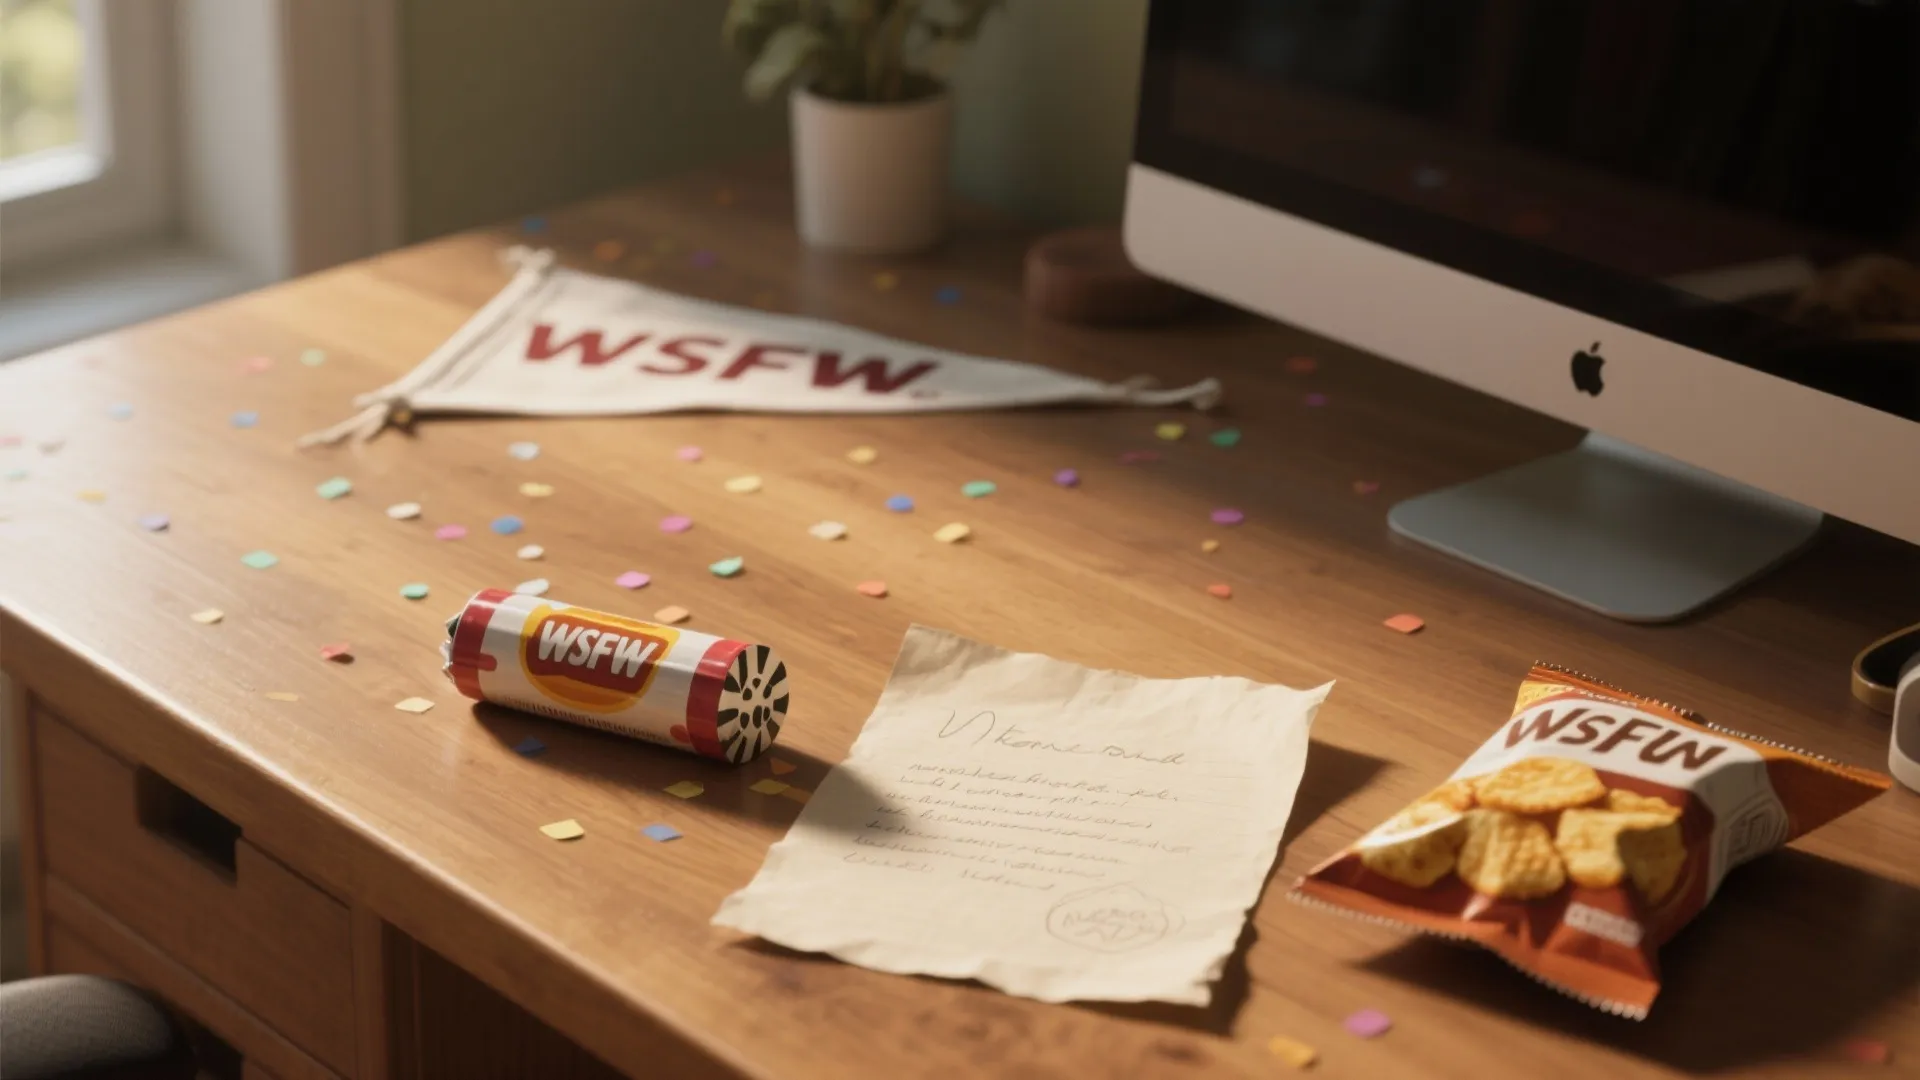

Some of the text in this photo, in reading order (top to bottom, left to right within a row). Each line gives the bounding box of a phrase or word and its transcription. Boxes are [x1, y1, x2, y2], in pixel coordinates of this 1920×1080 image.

[525, 325, 940, 394] WSFW
[537, 620, 659, 679] WSFW
[1504, 707, 1727, 771] WSFW
